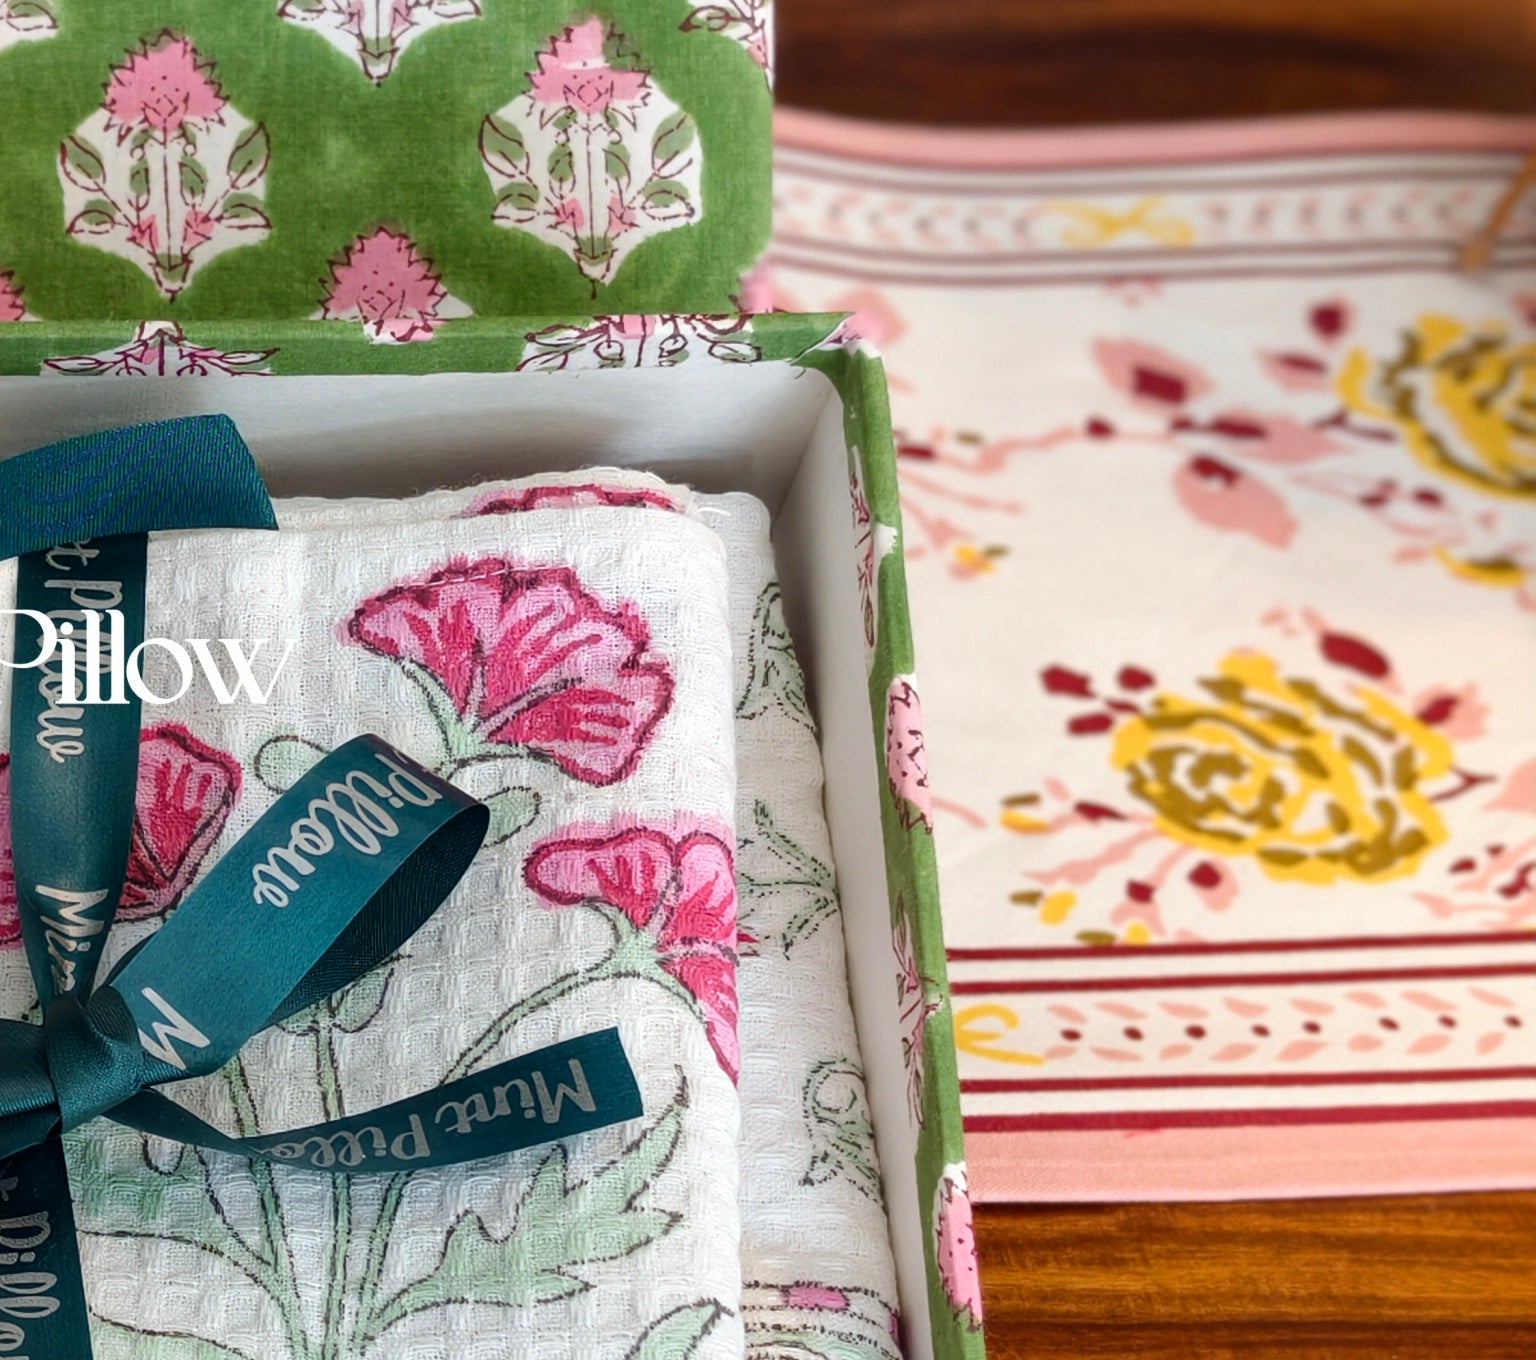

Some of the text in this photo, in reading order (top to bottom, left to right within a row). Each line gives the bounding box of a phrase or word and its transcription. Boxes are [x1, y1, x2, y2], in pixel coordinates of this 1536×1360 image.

[252, 752, 443, 908] Pillow
[34, 884, 110, 996] Min
[258, 1058, 597, 1168] Mint Pillo
